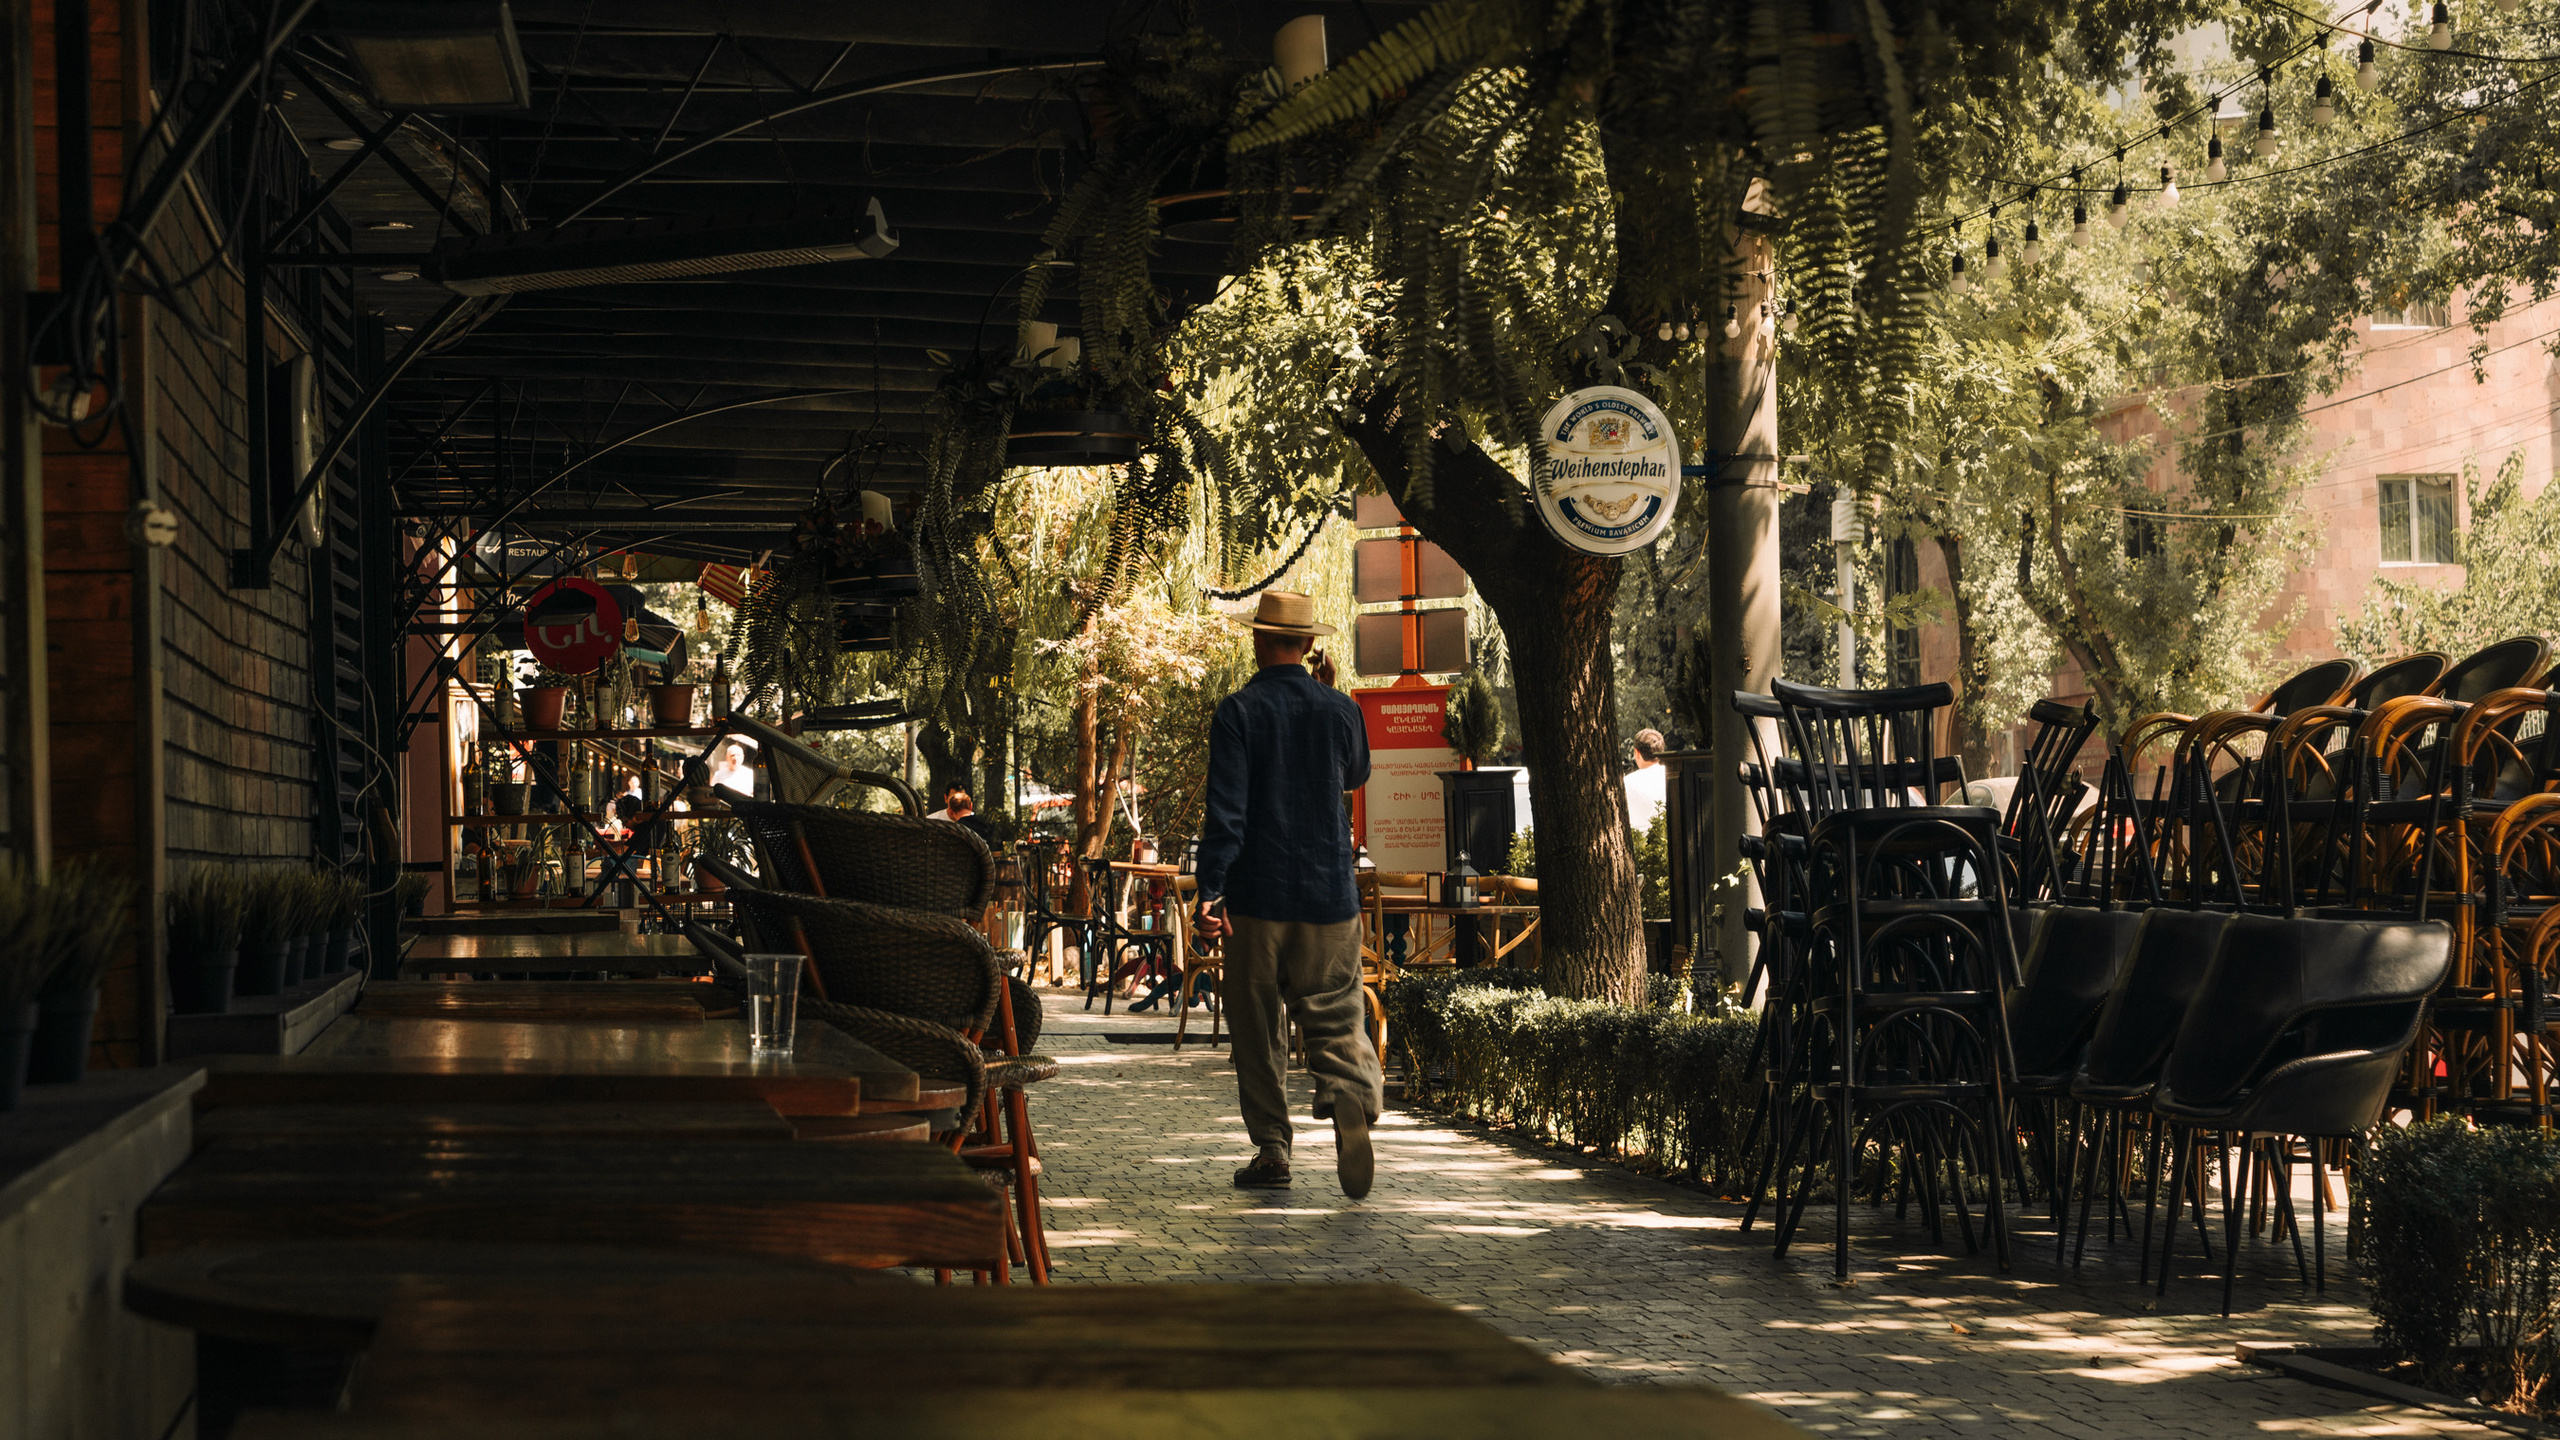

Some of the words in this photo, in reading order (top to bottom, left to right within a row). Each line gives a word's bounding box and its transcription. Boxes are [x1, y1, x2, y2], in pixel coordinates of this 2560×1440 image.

[1561, 422, 1572, 436] THE
[1570, 402, 1600, 422] WORLD'S
[1602, 402, 1628, 412] OLDEST
[1628, 408, 1656, 435] BREWERY
[1550, 456, 1666, 480] Weihenstephan
[1572, 516, 1606, 536] PREMIUM
[1609, 514, 1650, 536] BAVARICUM
[508, 548, 564, 558] RESTAURT
[1394, 715, 1426, 724] ԱՆՎՃԱՐ
[1386, 724, 1434, 734] ԿԱՅԱՆԱՏԵՂ
[1420, 792, 1440, 800] ՍՊԸ
